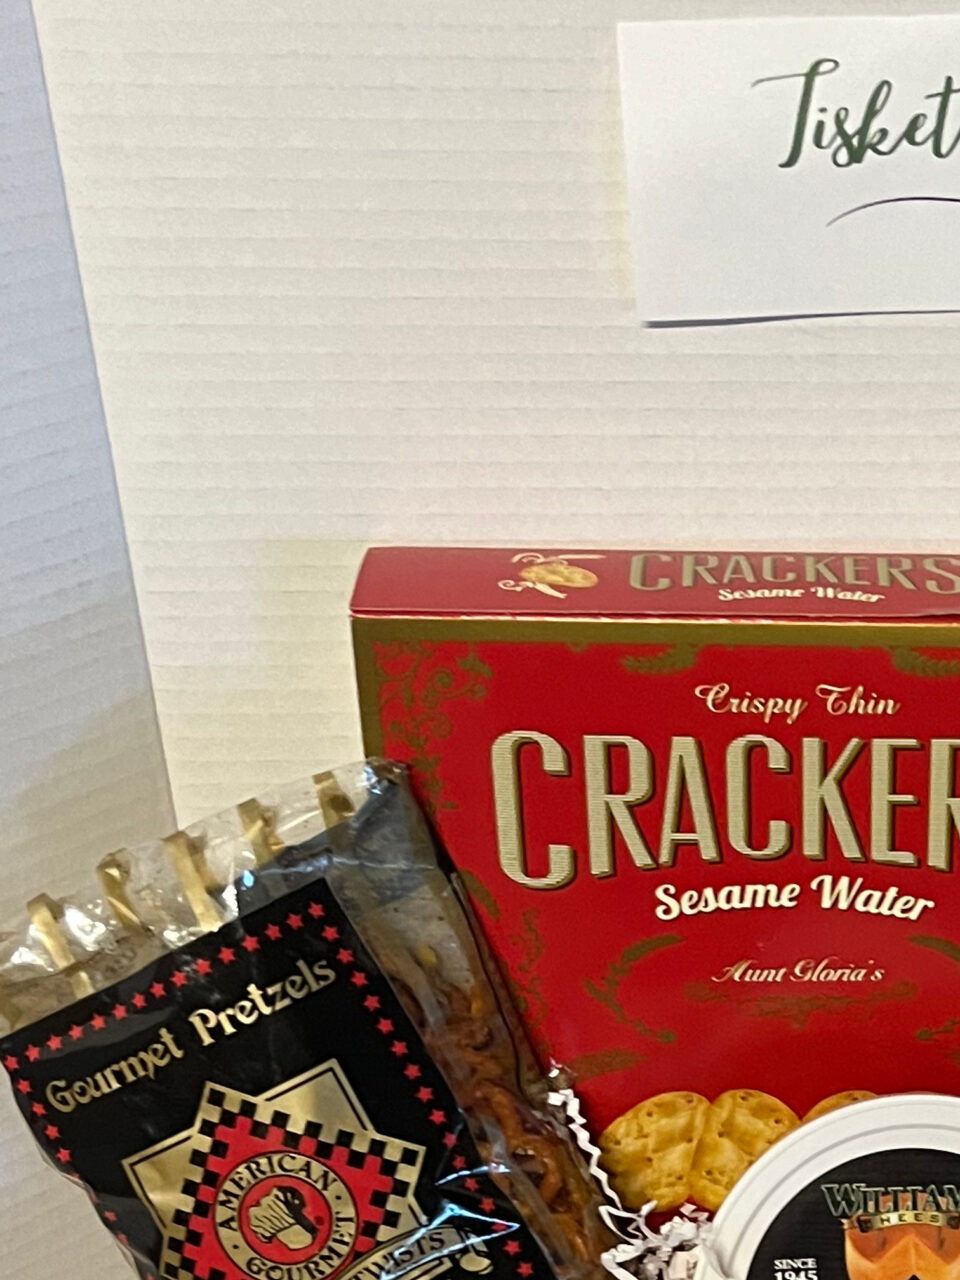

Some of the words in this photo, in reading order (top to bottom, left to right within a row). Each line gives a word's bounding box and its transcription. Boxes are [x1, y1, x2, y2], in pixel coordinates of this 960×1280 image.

[717, 586, 802, 603] Sesame
[810, 585, 885, 604] Water
[695, 684, 808, 724] Crispy
[815, 684, 901, 717] Thin
[654, 884, 800, 921] Sesame
[810, 875, 935, 921] Water
[712, 957, 792, 983] Aunt
[795, 958, 885, 983] Gloria's
[45, 1027, 184, 1112] Gourmet
[188, 959, 336, 1046] Pretzels
[219, 1154, 337, 1232] AMERICAN
[774, 1258, 817, 1270] SINCE
